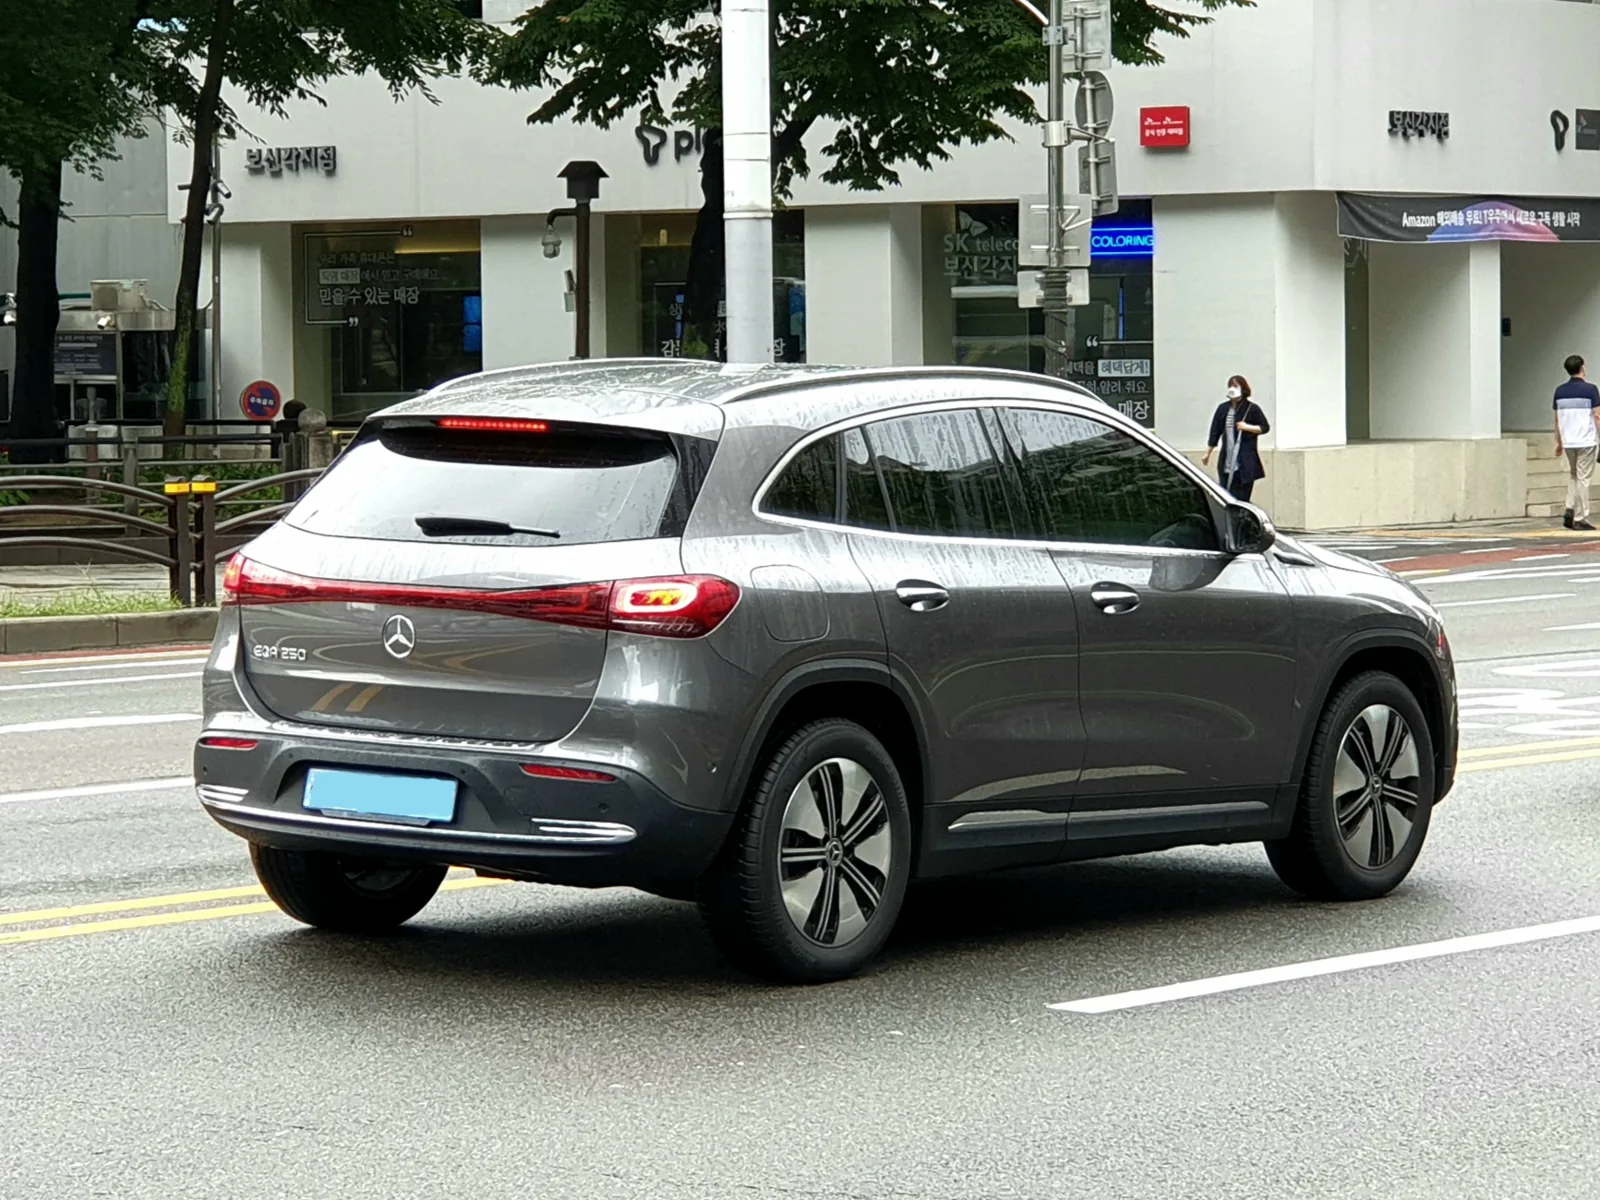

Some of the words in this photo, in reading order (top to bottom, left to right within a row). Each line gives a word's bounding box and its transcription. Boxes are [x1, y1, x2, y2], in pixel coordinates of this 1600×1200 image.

[1388, 110, 1449, 140] 보신각지점
[244, 146, 336, 173] 보신각지점
[1402, 211, 1436, 228] Amazon
[1567, 211, 1581, 228] 시작
[944, 232, 969, 253] SK
[1091, 234, 1154, 248] COLORING
[943, 254, 1017, 280] 보신각지
[320, 287, 345, 306] 믿을
[348, 287, 361, 304] 수
[364, 286, 391, 305] 있는
[393, 285, 420, 305] 매장
[1101, 360, 1148, 374] 혜택답게!
[253, 644, 278, 658] EQA
[281, 646, 306, 661] 250
